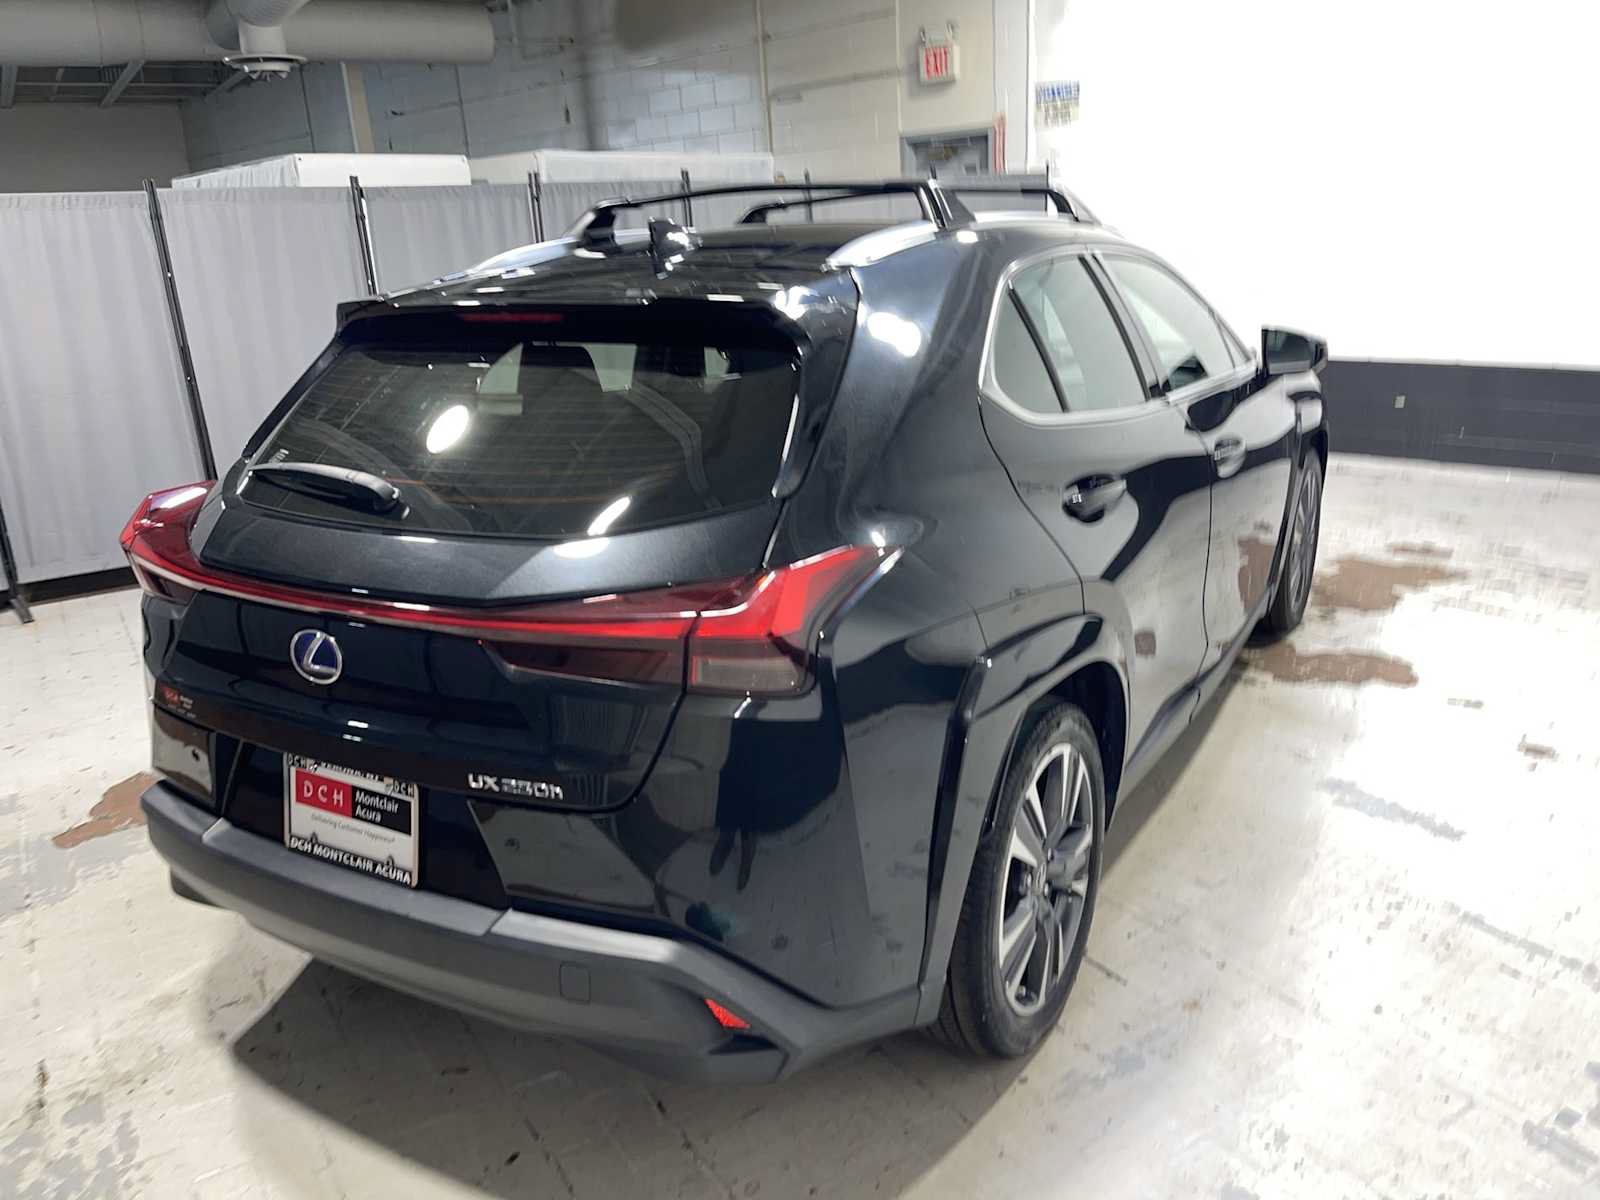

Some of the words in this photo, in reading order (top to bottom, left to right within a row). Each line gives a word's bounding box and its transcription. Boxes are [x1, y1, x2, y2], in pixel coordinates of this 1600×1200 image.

[924, 47, 949, 80] EXIT
[303, 779, 344, 808] DCH
[394, 780, 415, 798] DCH
[468, 773, 500, 793] UX
[355, 789, 400, 814] Montclair
[355, 804, 382, 823] Acura
[290, 836, 312, 853] DCH
[313, 842, 374, 872] MONTCLAIR
[375, 863, 411, 885] ACURA
